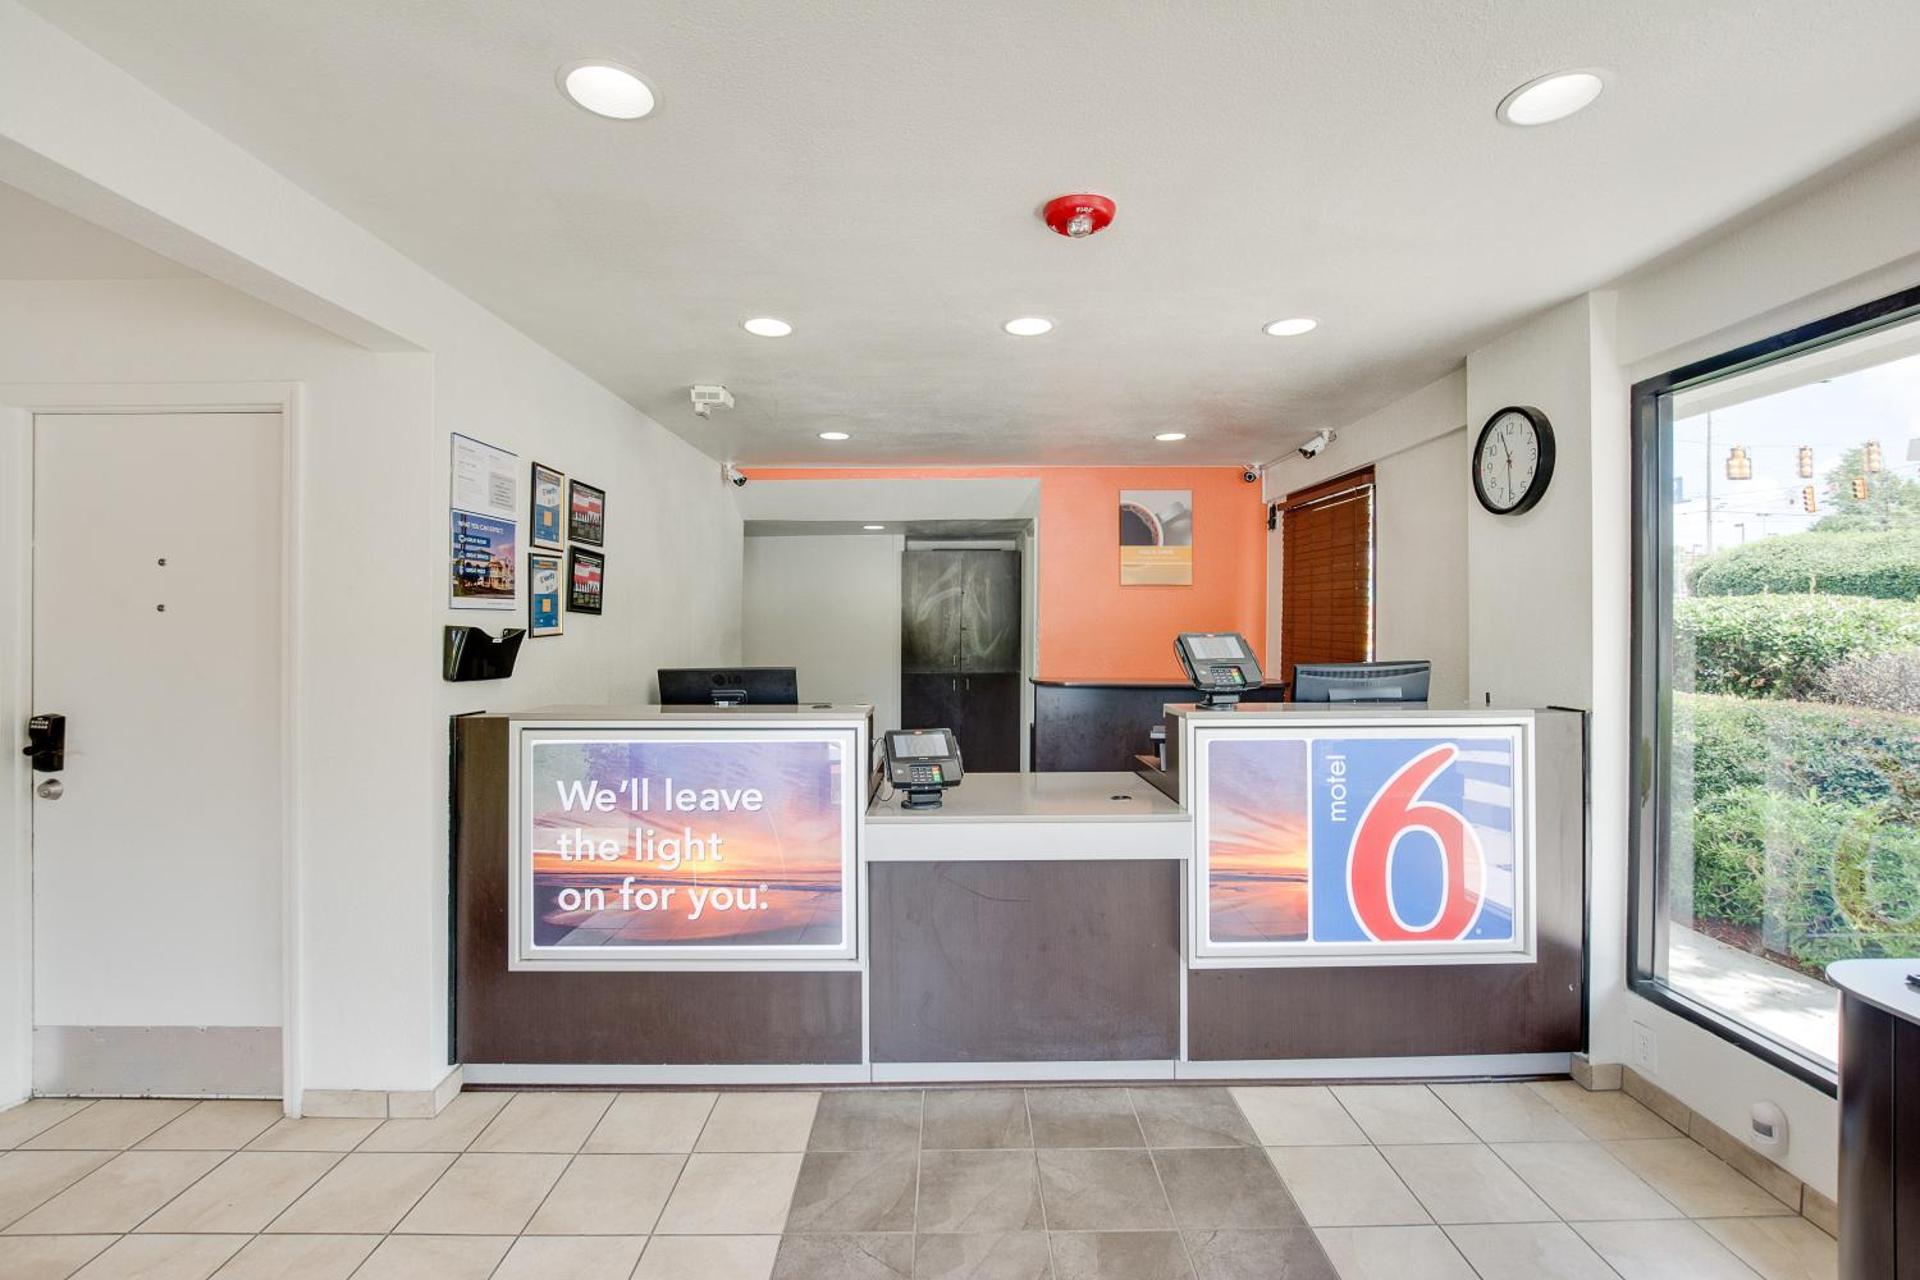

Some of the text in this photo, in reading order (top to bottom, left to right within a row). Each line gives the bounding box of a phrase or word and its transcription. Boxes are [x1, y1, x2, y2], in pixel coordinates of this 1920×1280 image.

[1505, 423, 1514, 436] 12
[1527, 431, 1533, 445] 2
[1488, 445, 1497, 457] 10
[1531, 447, 1537, 461] 3
[1487, 462, 1493, 473] 9
[1527, 466, 1533, 477] 4
[1490, 476, 1497, 489] 8
[1520, 480, 1527, 494] 5
[1498, 487, 1504, 499] 7
[556, 777, 764, 813] We’ll leave
[557, 827, 724, 871] the light
[1328, 742, 1486, 942] motel 6
[557, 886, 606, 913] on
[618, 876, 676, 912] for
